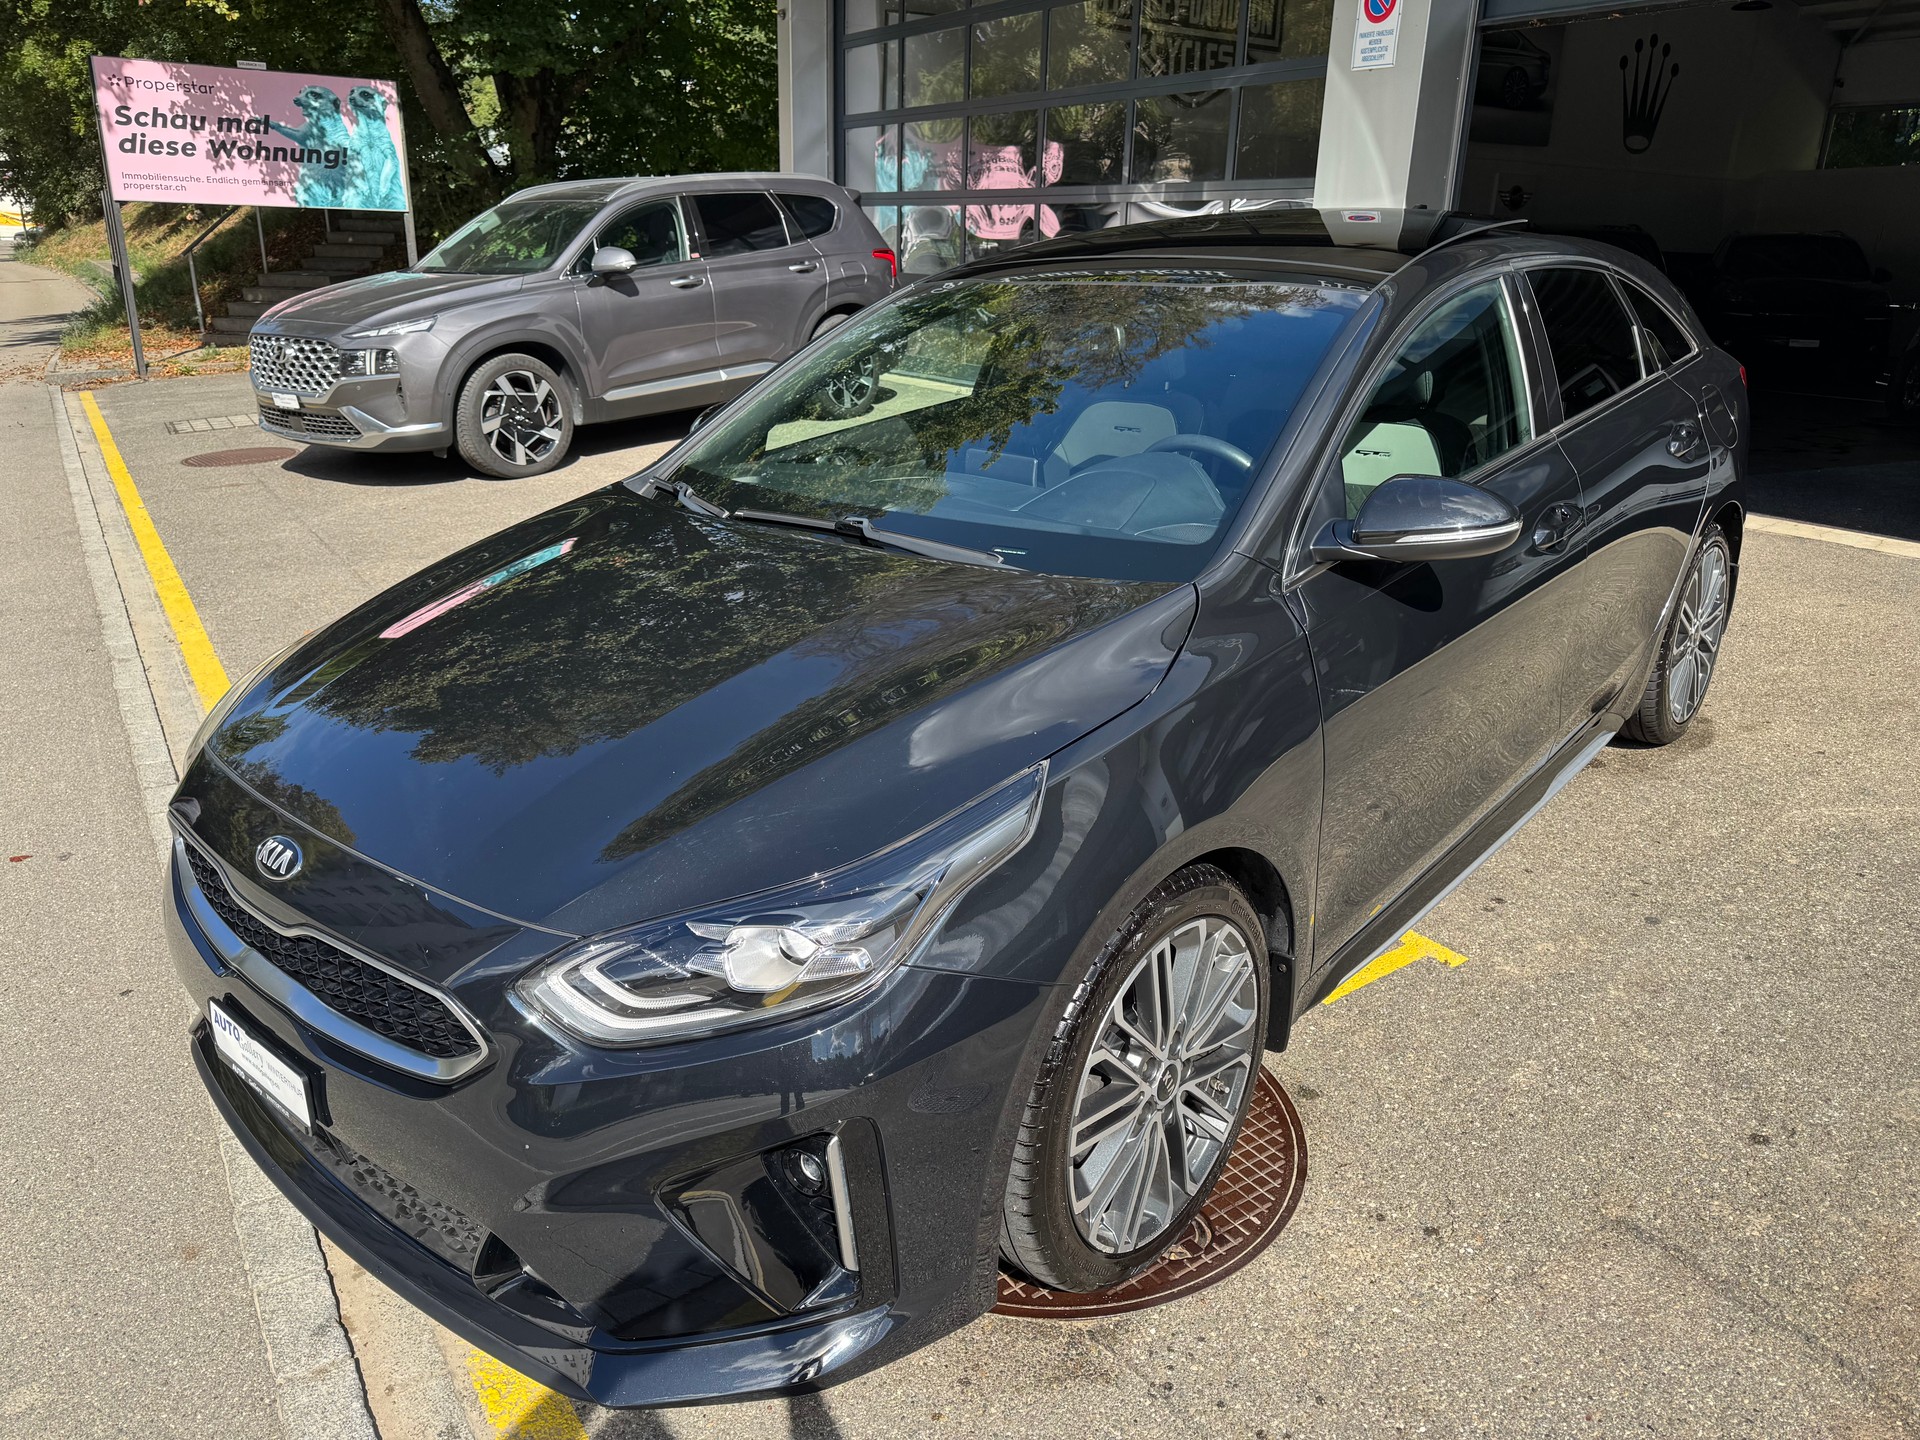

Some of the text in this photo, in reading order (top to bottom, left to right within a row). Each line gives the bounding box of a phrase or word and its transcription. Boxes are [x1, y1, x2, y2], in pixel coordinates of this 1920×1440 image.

[124, 76, 214, 94] Properstar
[115, 105, 270, 134] Schau mal
[119, 133, 348, 169] diese Wohnung!
[121, 171, 204, 184] Immobiliensuche.
[206, 176, 240, 185] Endlich
[123, 182, 187, 192] properstar.ch
[258, 839, 294, 875] KIA
[213, 1009, 241, 1042] AUTO
